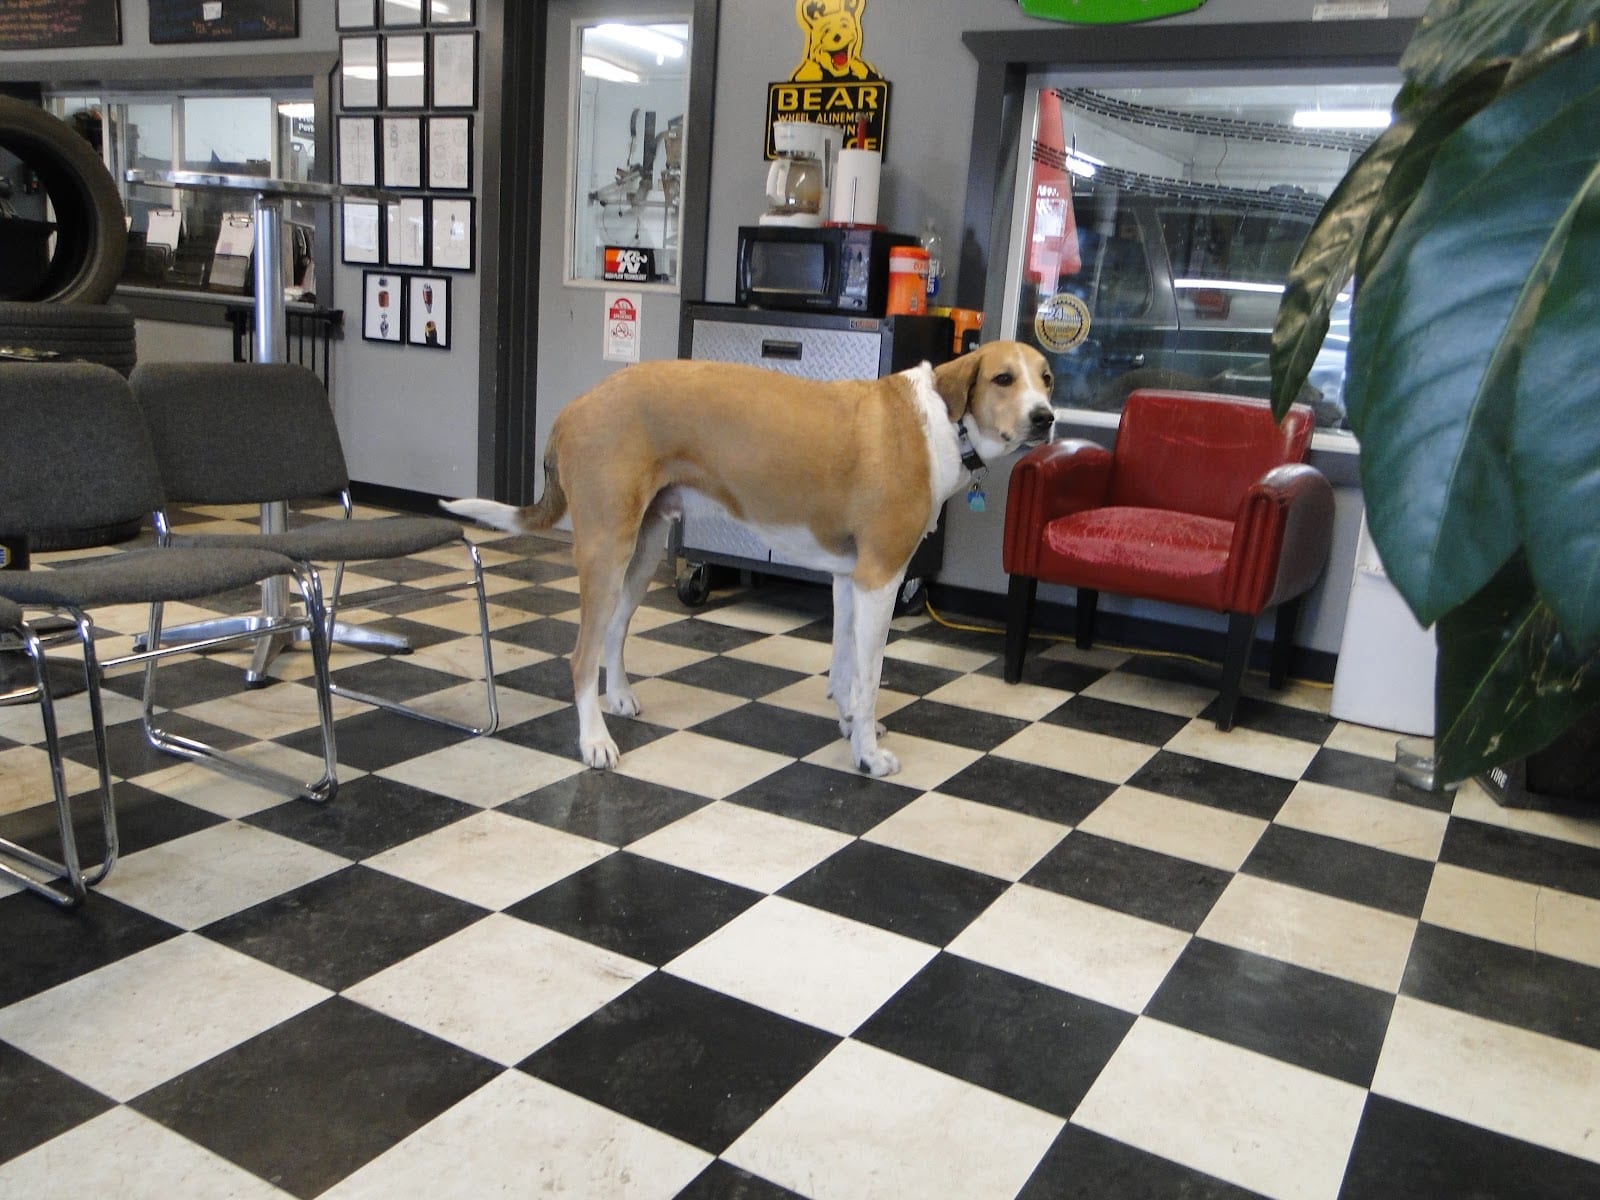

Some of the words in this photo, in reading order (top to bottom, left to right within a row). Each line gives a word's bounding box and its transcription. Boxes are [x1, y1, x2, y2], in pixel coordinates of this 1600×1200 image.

[777, 87, 878, 111] BEAR
[777, 112, 810, 122] WHEEL
[816, 112, 875, 123] ALINEMT
[1490, 766, 1508, 789] TIRE
